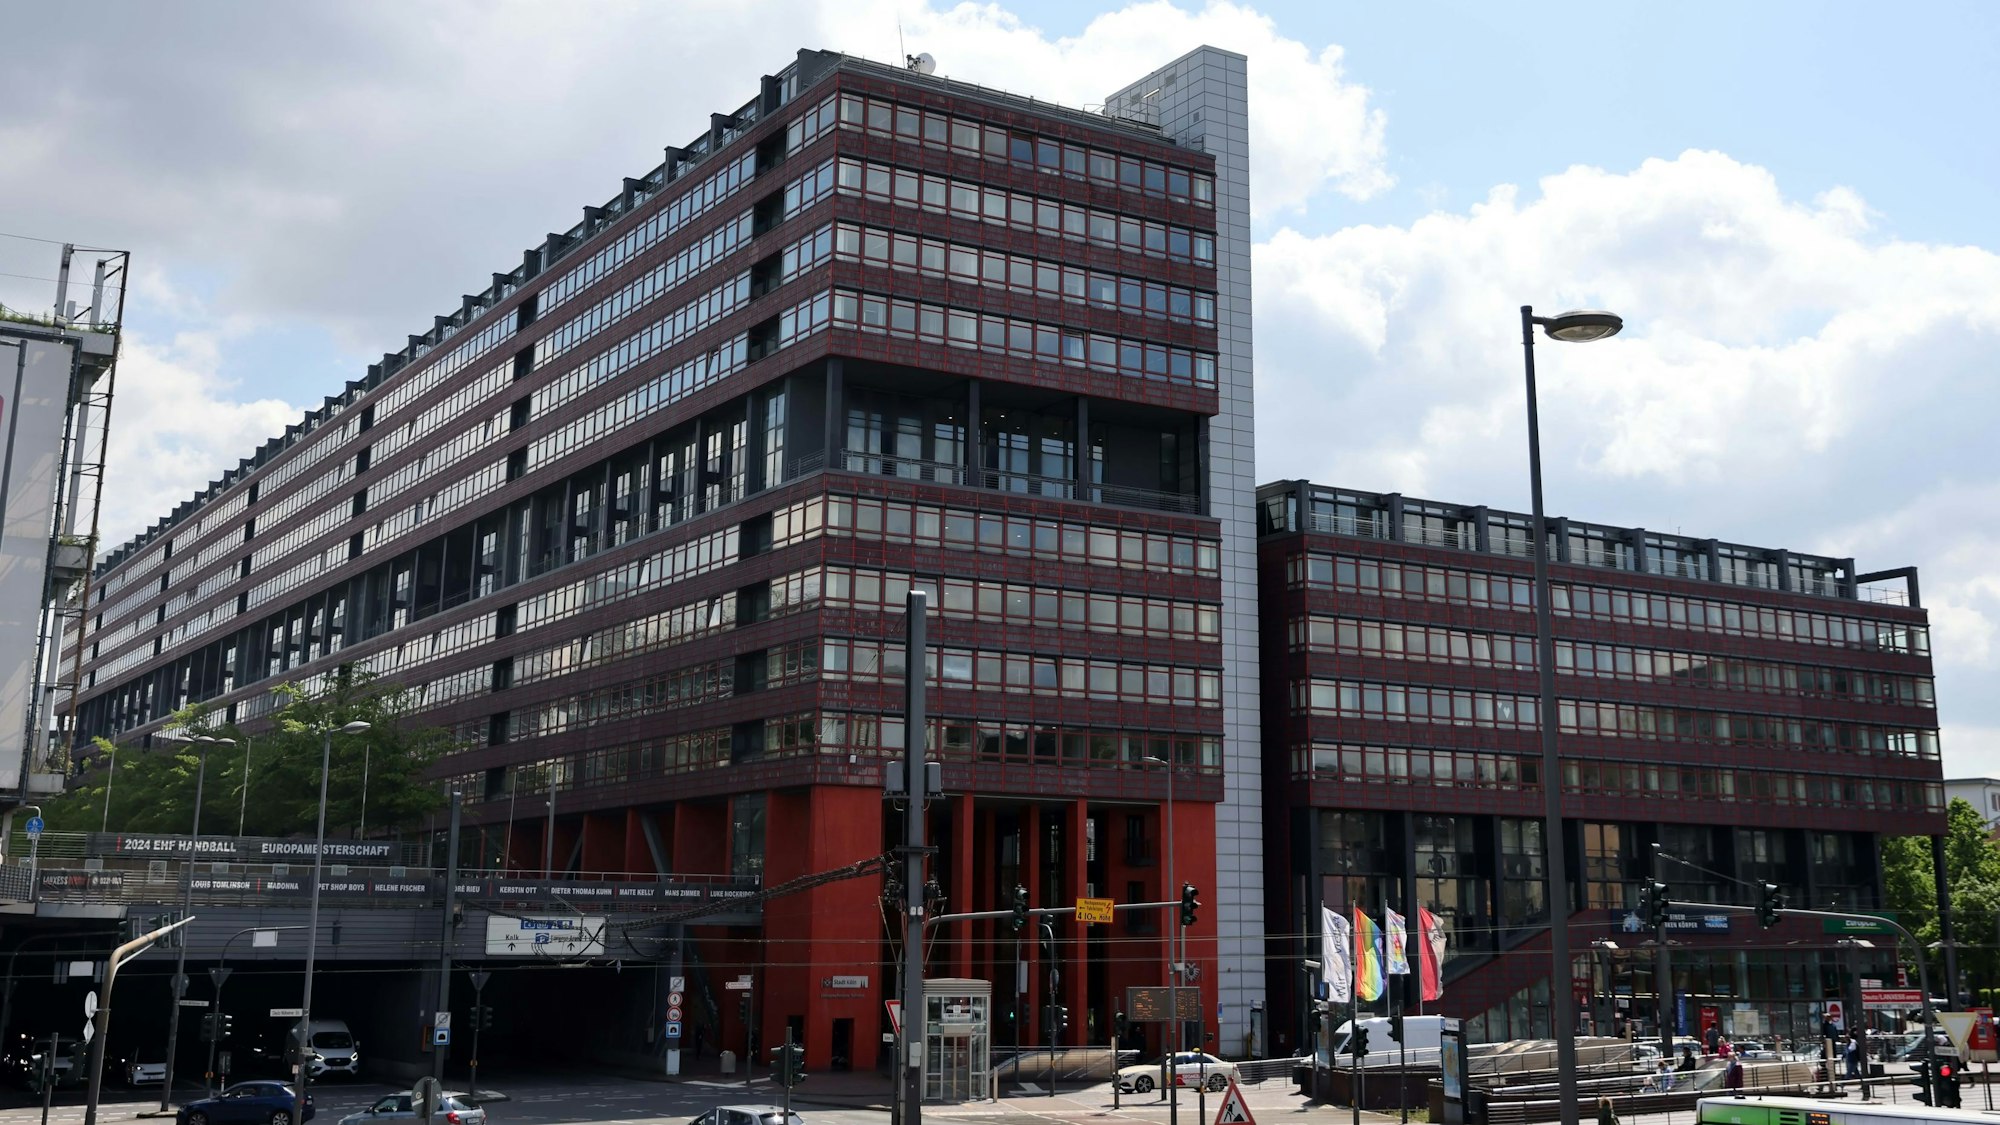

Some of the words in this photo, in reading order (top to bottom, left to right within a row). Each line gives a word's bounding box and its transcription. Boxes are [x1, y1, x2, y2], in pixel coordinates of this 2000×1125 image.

[124, 839, 151, 850] 2024
[153, 840, 176, 851] EHF
[178, 840, 237, 853] HANDBALL
[261, 843, 390, 856] EUROPAMESTERSCHAFT
[190, 880, 211, 889] LOUIS
[212, 881, 250, 890] TOMLINSON
[267, 882, 299, 890] MADONNA
[318, 883, 329, 891] PET
[330, 883, 347, 891] SHOP
[348, 884, 365, 892] BOYS
[374, 884, 399, 892] HELENE
[399, 884, 425, 892] FISCHER
[455, 884, 466, 893] DRÉ
[466, 885, 480, 893] RIEU
[499, 886, 525, 894] KERSTIN
[551, 887, 571, 895] DIETER
[619, 888, 637, 896] MAITE
[664, 889, 680, 897] HANS
[1678, 920, 1698, 929] KÖRPER
